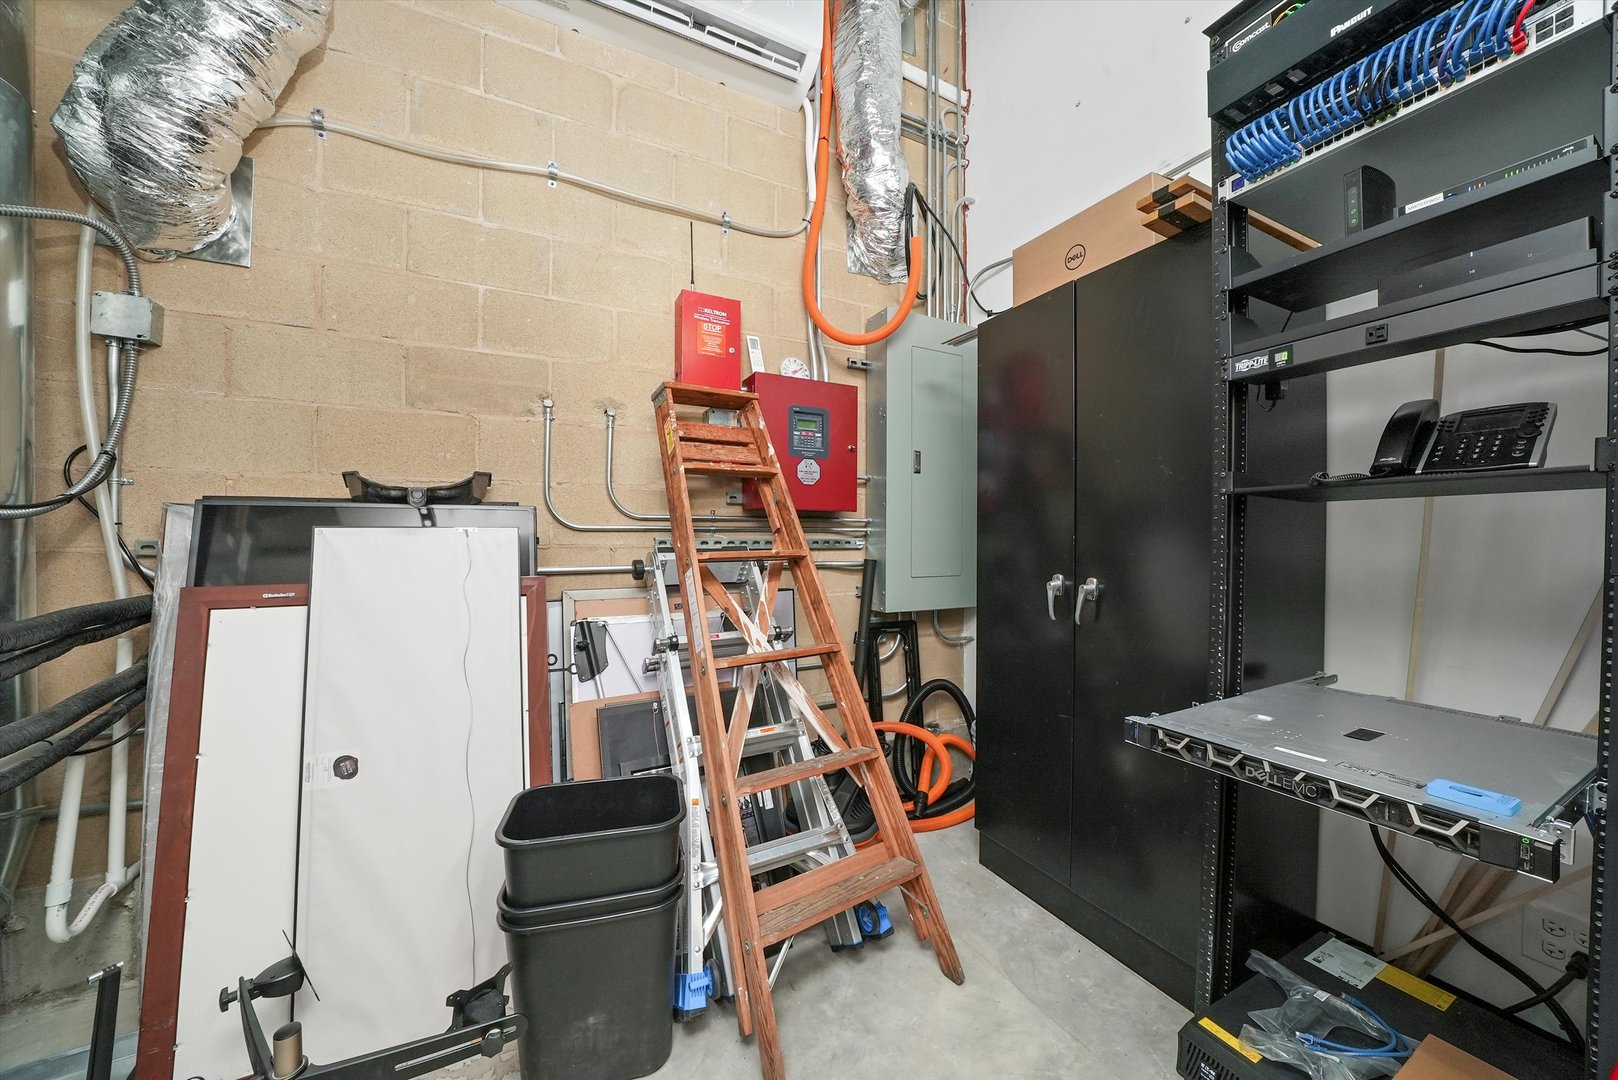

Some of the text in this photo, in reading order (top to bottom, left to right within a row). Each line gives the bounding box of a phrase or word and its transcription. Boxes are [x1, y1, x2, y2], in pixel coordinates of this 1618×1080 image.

[1330, 6, 1373, 37] PANDUIT
[1067, 252, 1083, 264] DELL
[703, 308, 728, 317] KELTRON
[703, 322, 722, 332] STOP
[1245, 765, 1317, 798] DELL EMC
